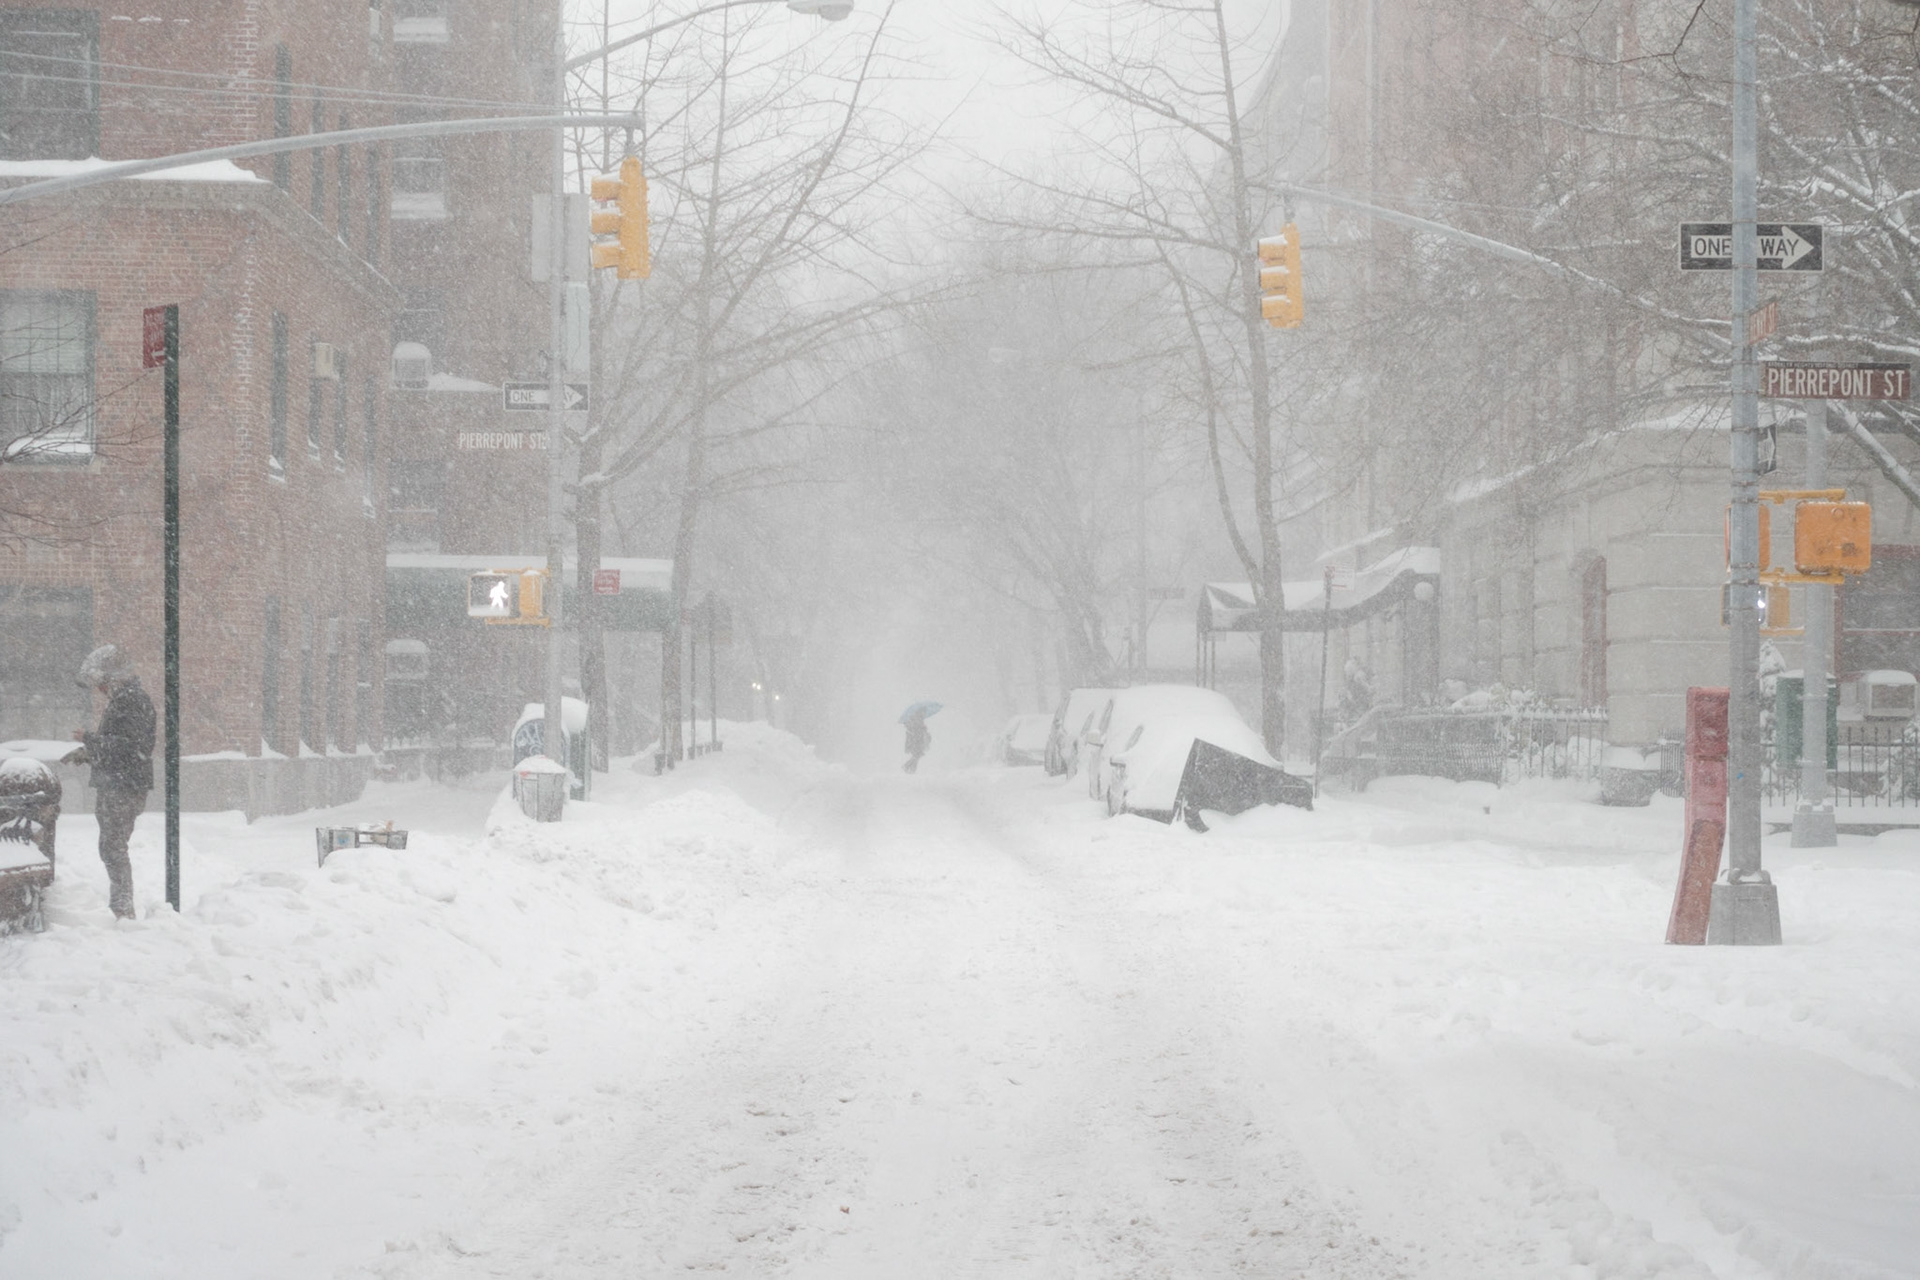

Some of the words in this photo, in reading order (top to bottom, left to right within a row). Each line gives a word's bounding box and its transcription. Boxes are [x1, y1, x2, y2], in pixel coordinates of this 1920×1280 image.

[1695, 237, 1732, 256] ONE
[1760, 238, 1799, 256] WAY
[1768, 368, 1874, 396] PIERREPONT
[1884, 370, 1905, 397] ST
[511, 390, 534, 402] ONE
[459, 432, 524, 449] PIERREPONT
